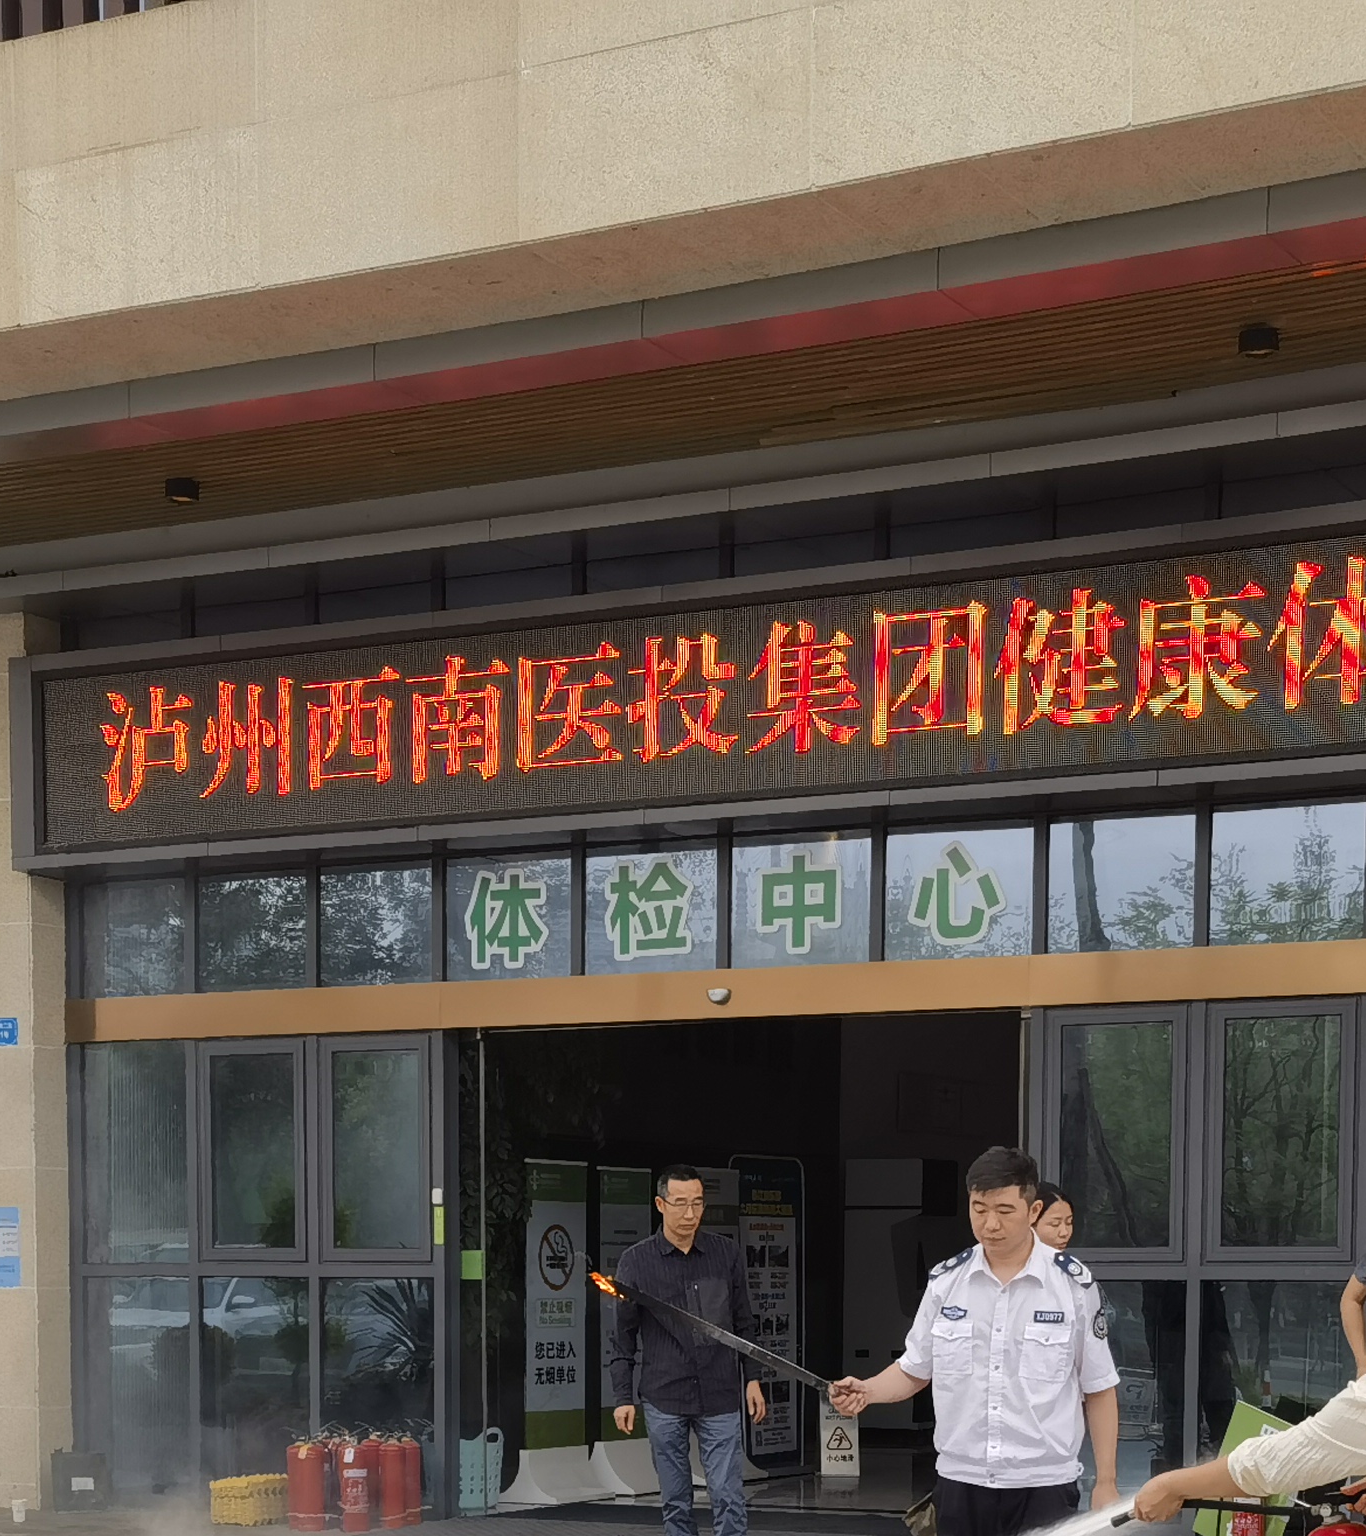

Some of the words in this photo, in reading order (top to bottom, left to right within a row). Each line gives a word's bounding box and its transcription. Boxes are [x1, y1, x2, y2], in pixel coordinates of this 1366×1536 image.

[467, 842, 1005, 968] 体检中心
[534, 1341, 577, 1359] 您已进入
[534, 1366, 577, 1385] 无烟单位
